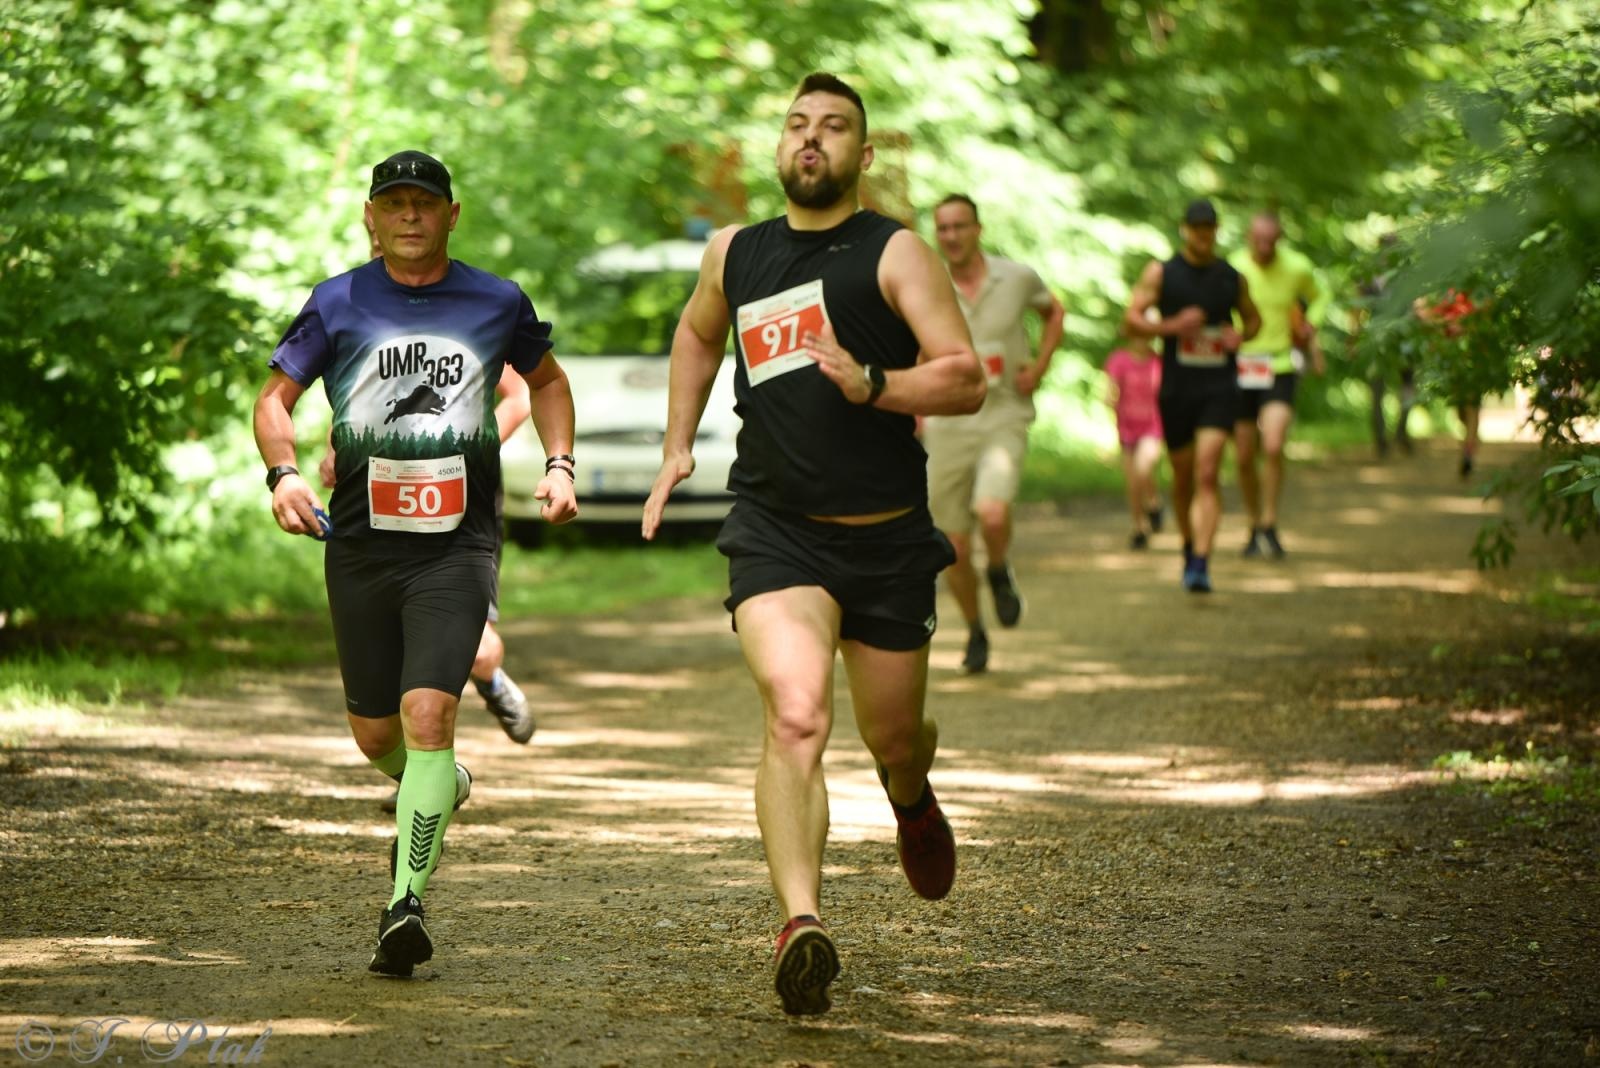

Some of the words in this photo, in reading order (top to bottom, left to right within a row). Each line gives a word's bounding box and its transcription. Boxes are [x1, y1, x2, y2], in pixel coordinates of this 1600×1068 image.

[761, 315, 800, 357] 97
[378, 342, 427, 380] UMR
[422, 353, 464, 388] 363
[397, 485, 442, 515] 50
